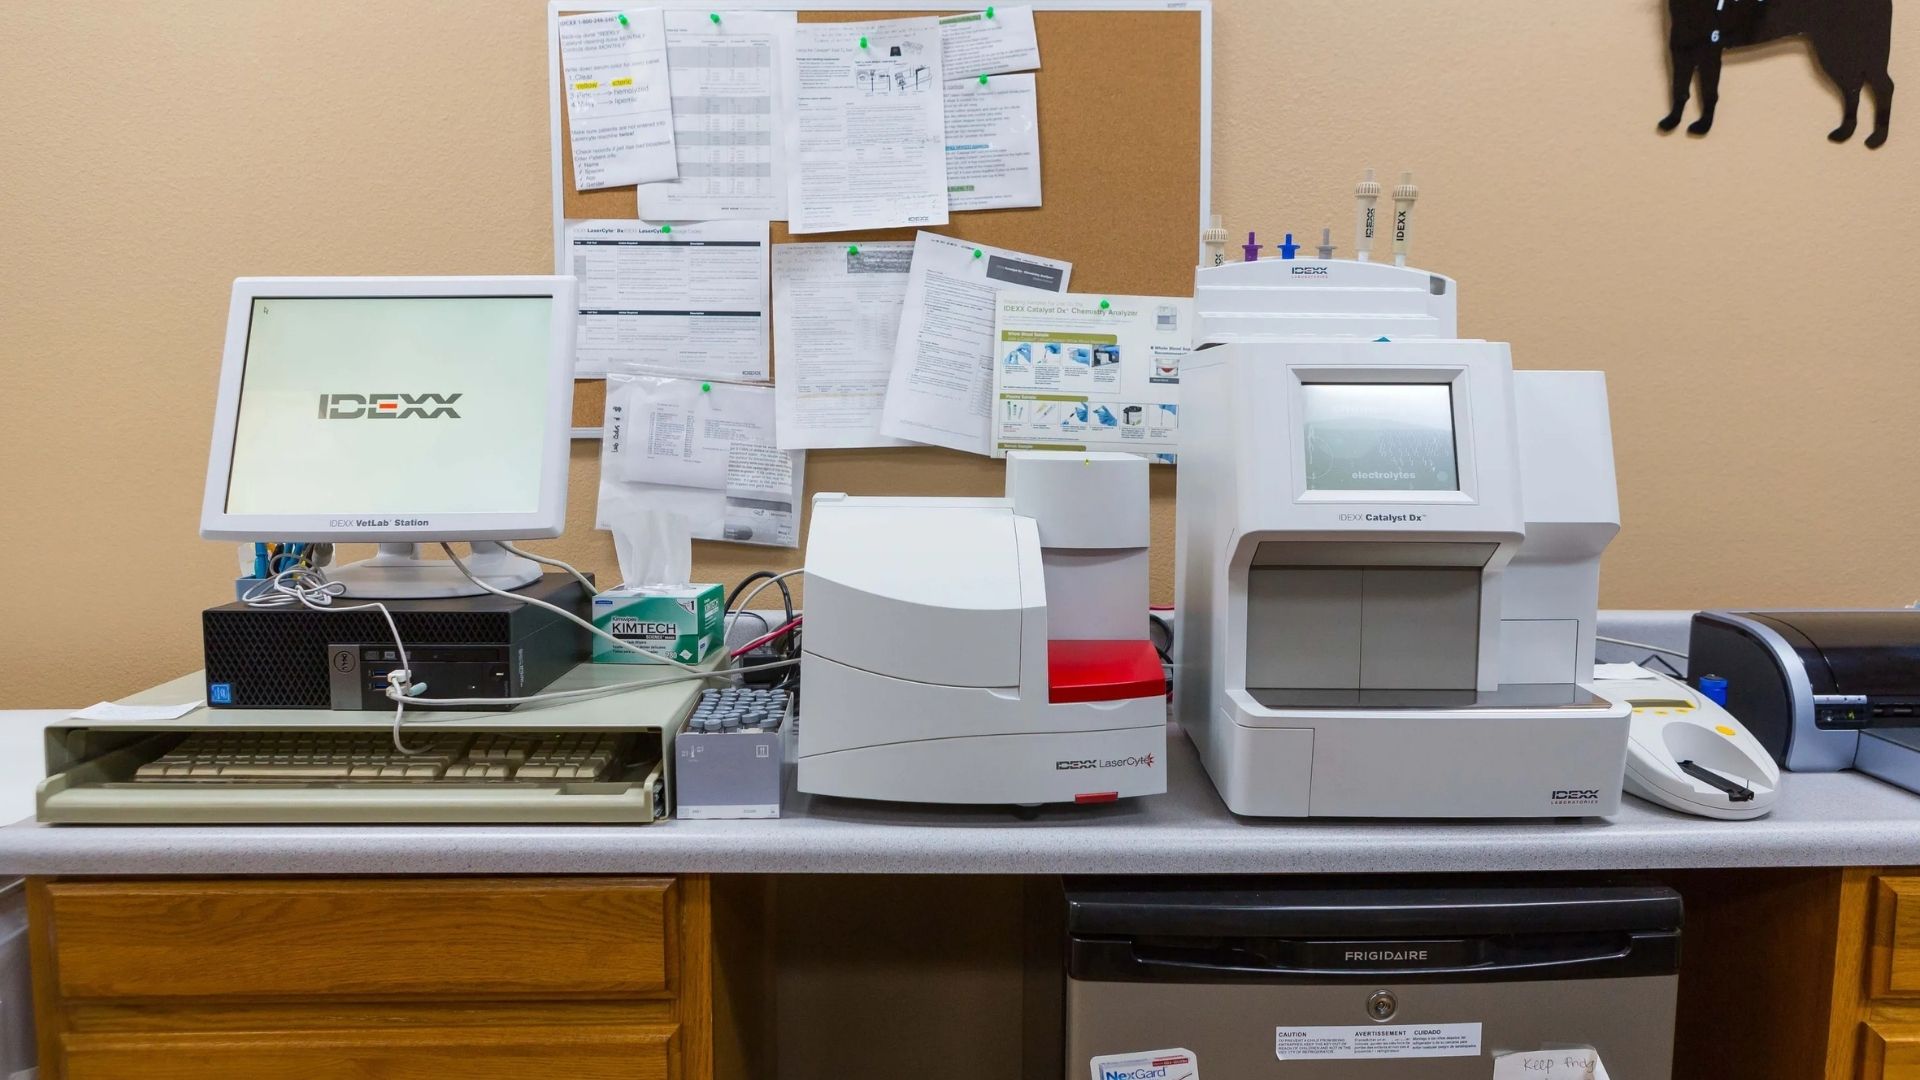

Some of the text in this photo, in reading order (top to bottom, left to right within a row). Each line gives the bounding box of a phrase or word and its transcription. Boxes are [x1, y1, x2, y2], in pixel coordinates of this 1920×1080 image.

[1711, 30, 1720, 42] 6
[1396, 211, 1406, 241] IDEXX
[1027, 306, 1054, 314] Catalyst
[1072, 308, 1106, 317] Chemistry
[318, 394, 462, 419] IDEXX
[1352, 471, 1416, 480] electrolytes
[1366, 514, 1406, 522] Catalyst
[612, 623, 676, 633] KIMTECH
[1056, 760, 1097, 770] IDEXX
[1552, 790, 1599, 799] IDEXX
[1345, 951, 1428, 960] FRIGIDAIRE
[1524, 1059, 1553, 1074] Keep
[1106, 1067, 1166, 1080] NexGard
